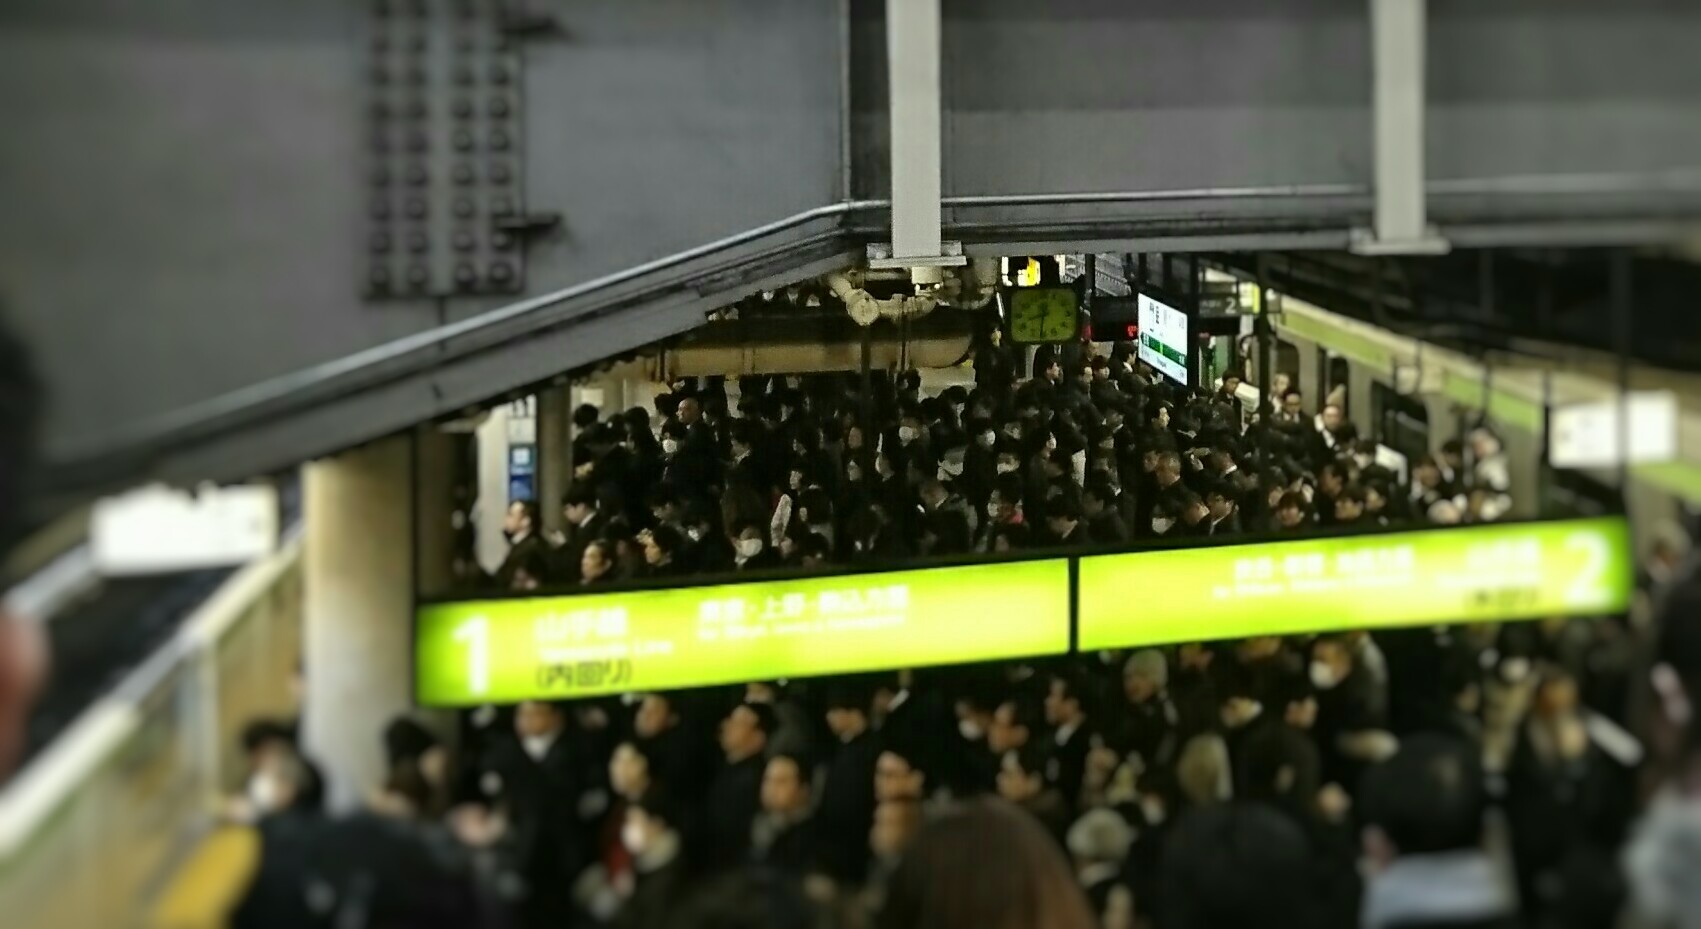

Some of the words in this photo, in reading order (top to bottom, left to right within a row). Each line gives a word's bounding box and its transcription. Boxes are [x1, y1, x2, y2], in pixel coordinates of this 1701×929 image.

[1225, 297, 1237, 314] 2
[1564, 531, 1614, 611] 2
[453, 614, 491, 696] 1
